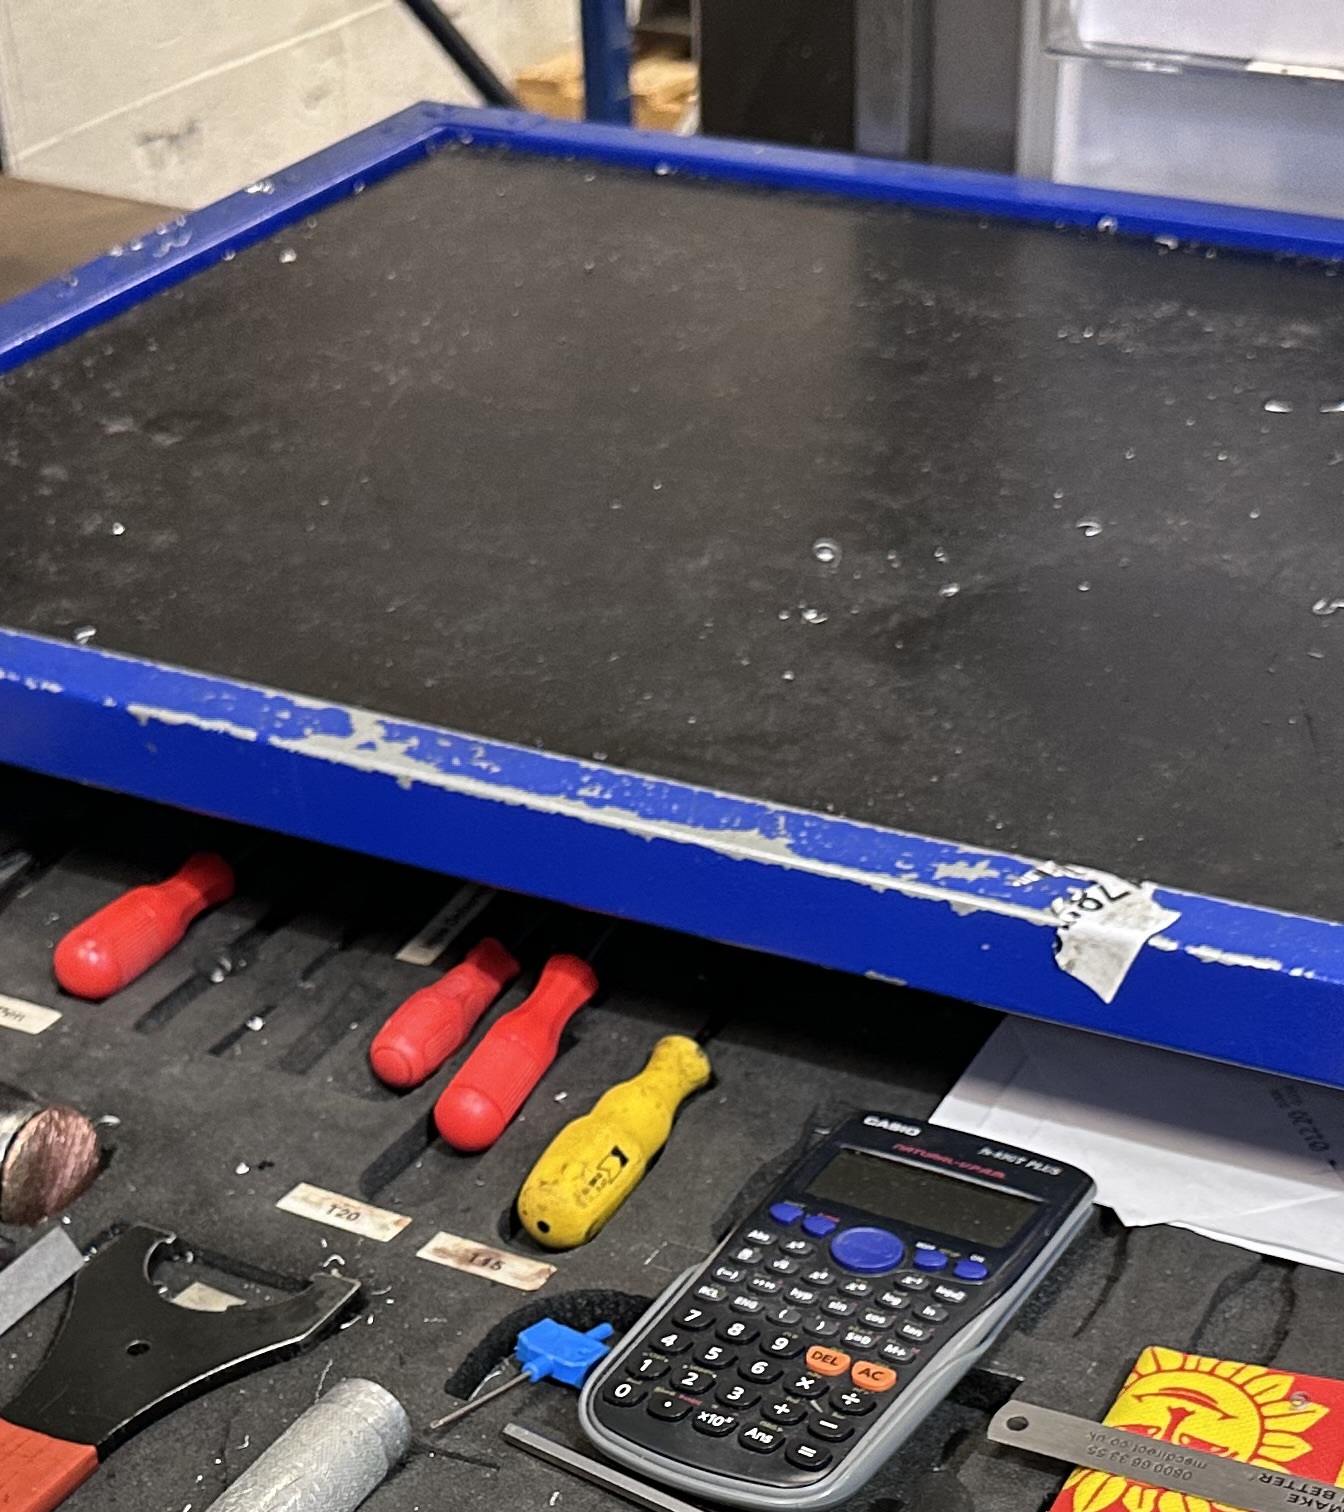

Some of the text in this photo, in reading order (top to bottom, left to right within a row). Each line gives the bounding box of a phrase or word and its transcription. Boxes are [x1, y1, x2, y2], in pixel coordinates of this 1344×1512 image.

[862, 1115, 922, 1137] CASIO
[326, 1203, 362, 1222] T20
[660, 1334, 678, 1347] 4
[704, 1346, 723, 1360] 5
[750, 1361, 769, 1375] 6
[683, 1308, 885, 1381] 7 8 9 DEL AC
[639, 1358, 653, 1372] 1
[681, 1371, 699, 1386] 2
[726, 1386, 745, 1400] 3
[614, 1383, 632, 1398] 0
[744, 1427, 774, 1444] Ans
[1153, 1461, 1194, 1481] 0800
[1257, 1472, 1340, 1500] BETTER
